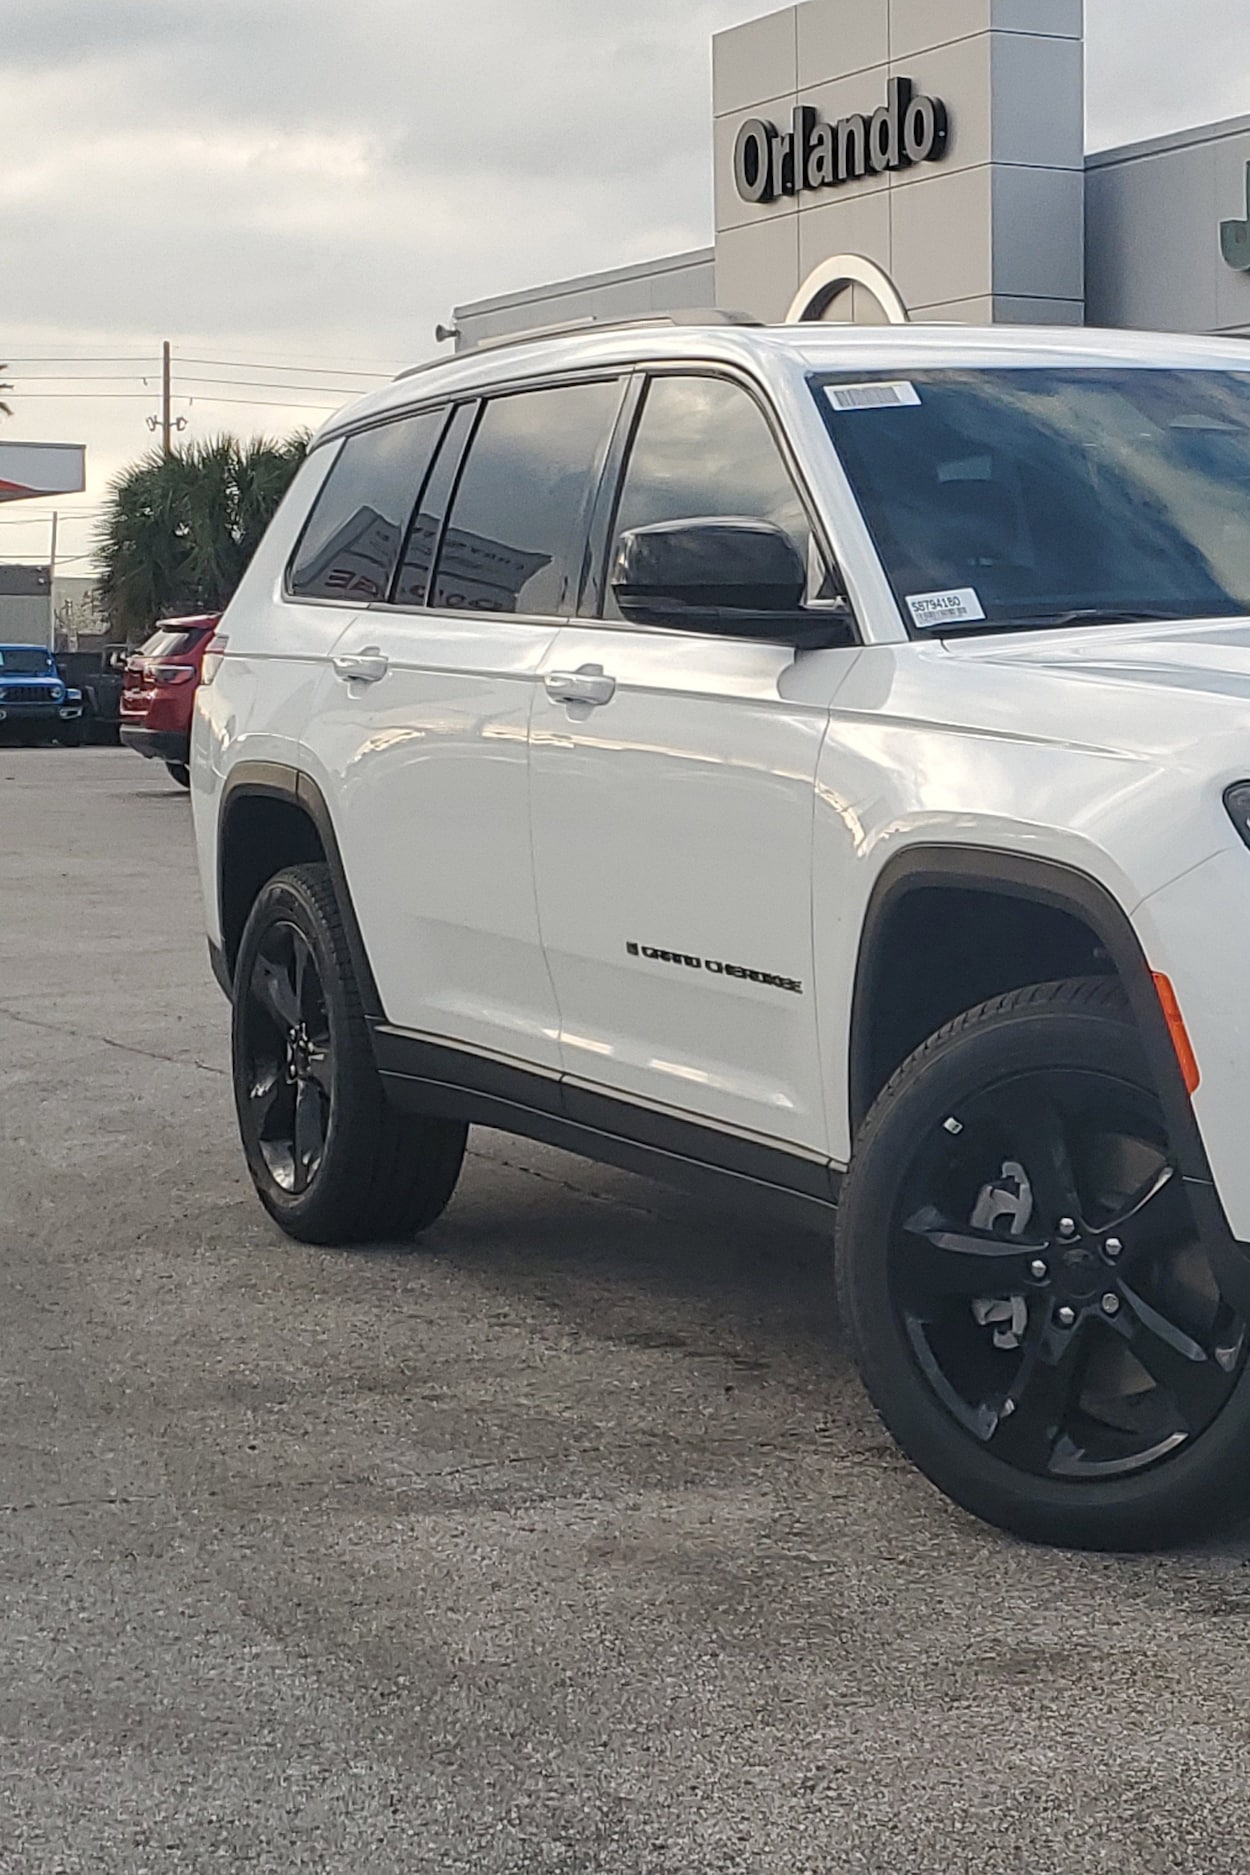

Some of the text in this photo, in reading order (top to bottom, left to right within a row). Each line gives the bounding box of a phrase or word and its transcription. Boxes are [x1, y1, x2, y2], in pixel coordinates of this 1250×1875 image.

[734, 76, 947, 203] Orlando
[641, 945, 803, 994] GRAND CHEROKEE
